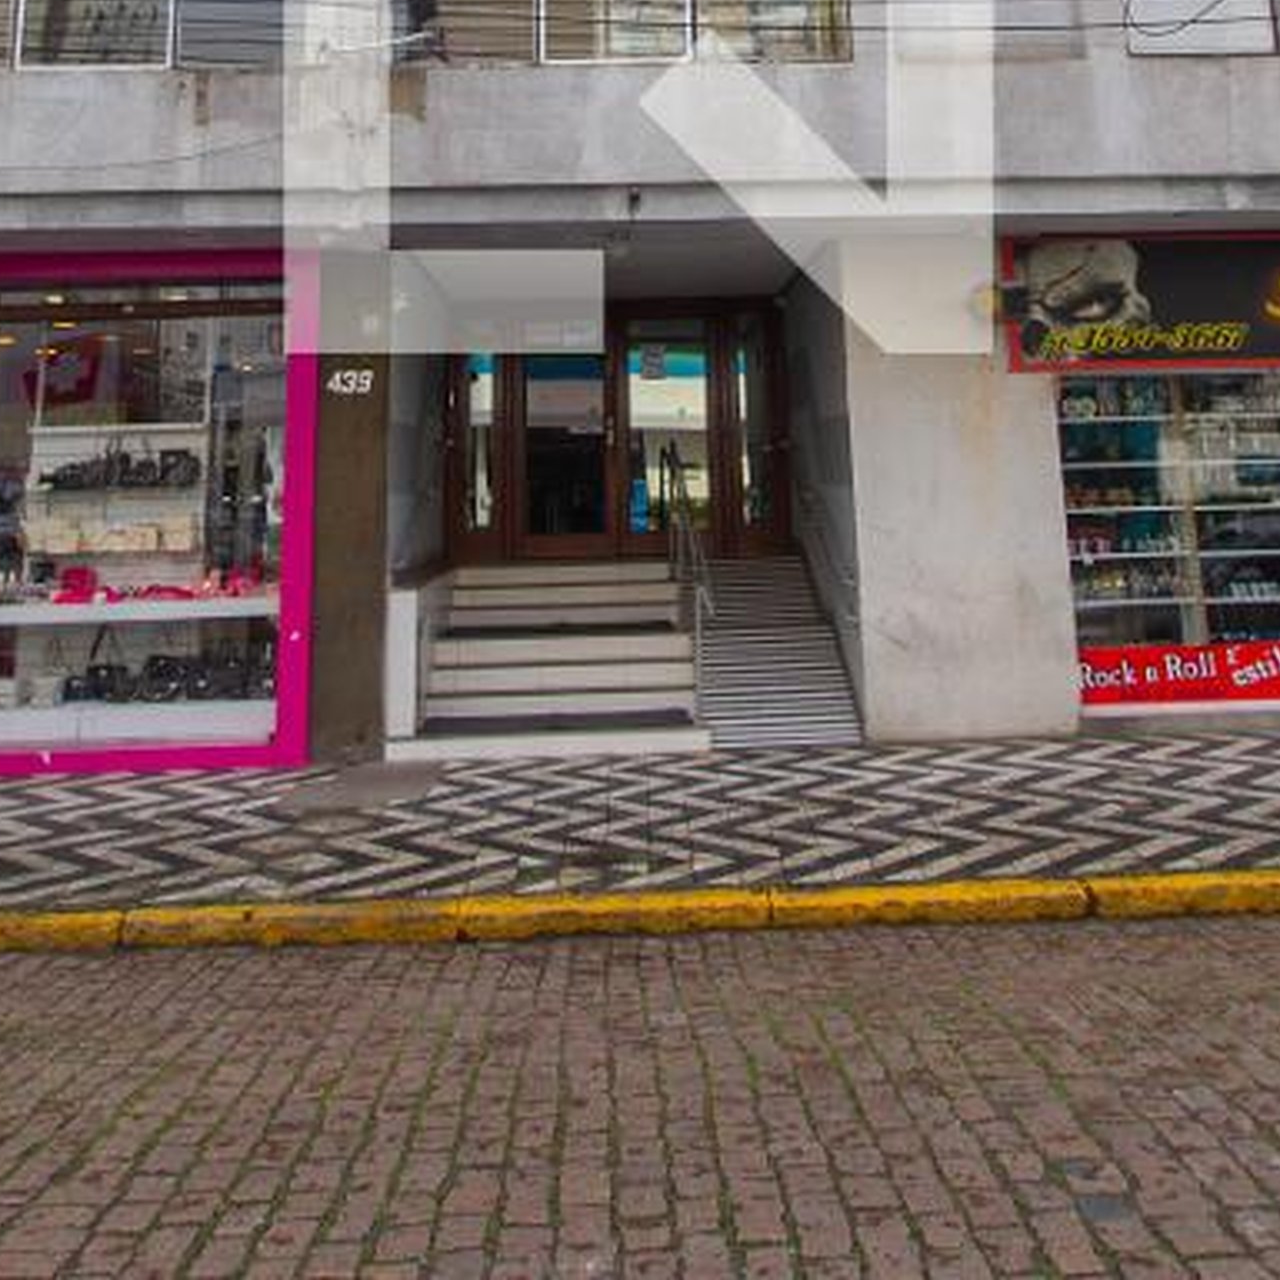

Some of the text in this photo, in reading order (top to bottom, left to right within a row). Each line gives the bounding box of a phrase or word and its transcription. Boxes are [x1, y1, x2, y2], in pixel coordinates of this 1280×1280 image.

[326, 369, 374, 394] 439
[1076, 660, 1137, 690] Rock
[1164, 651, 1217, 681] Roll
